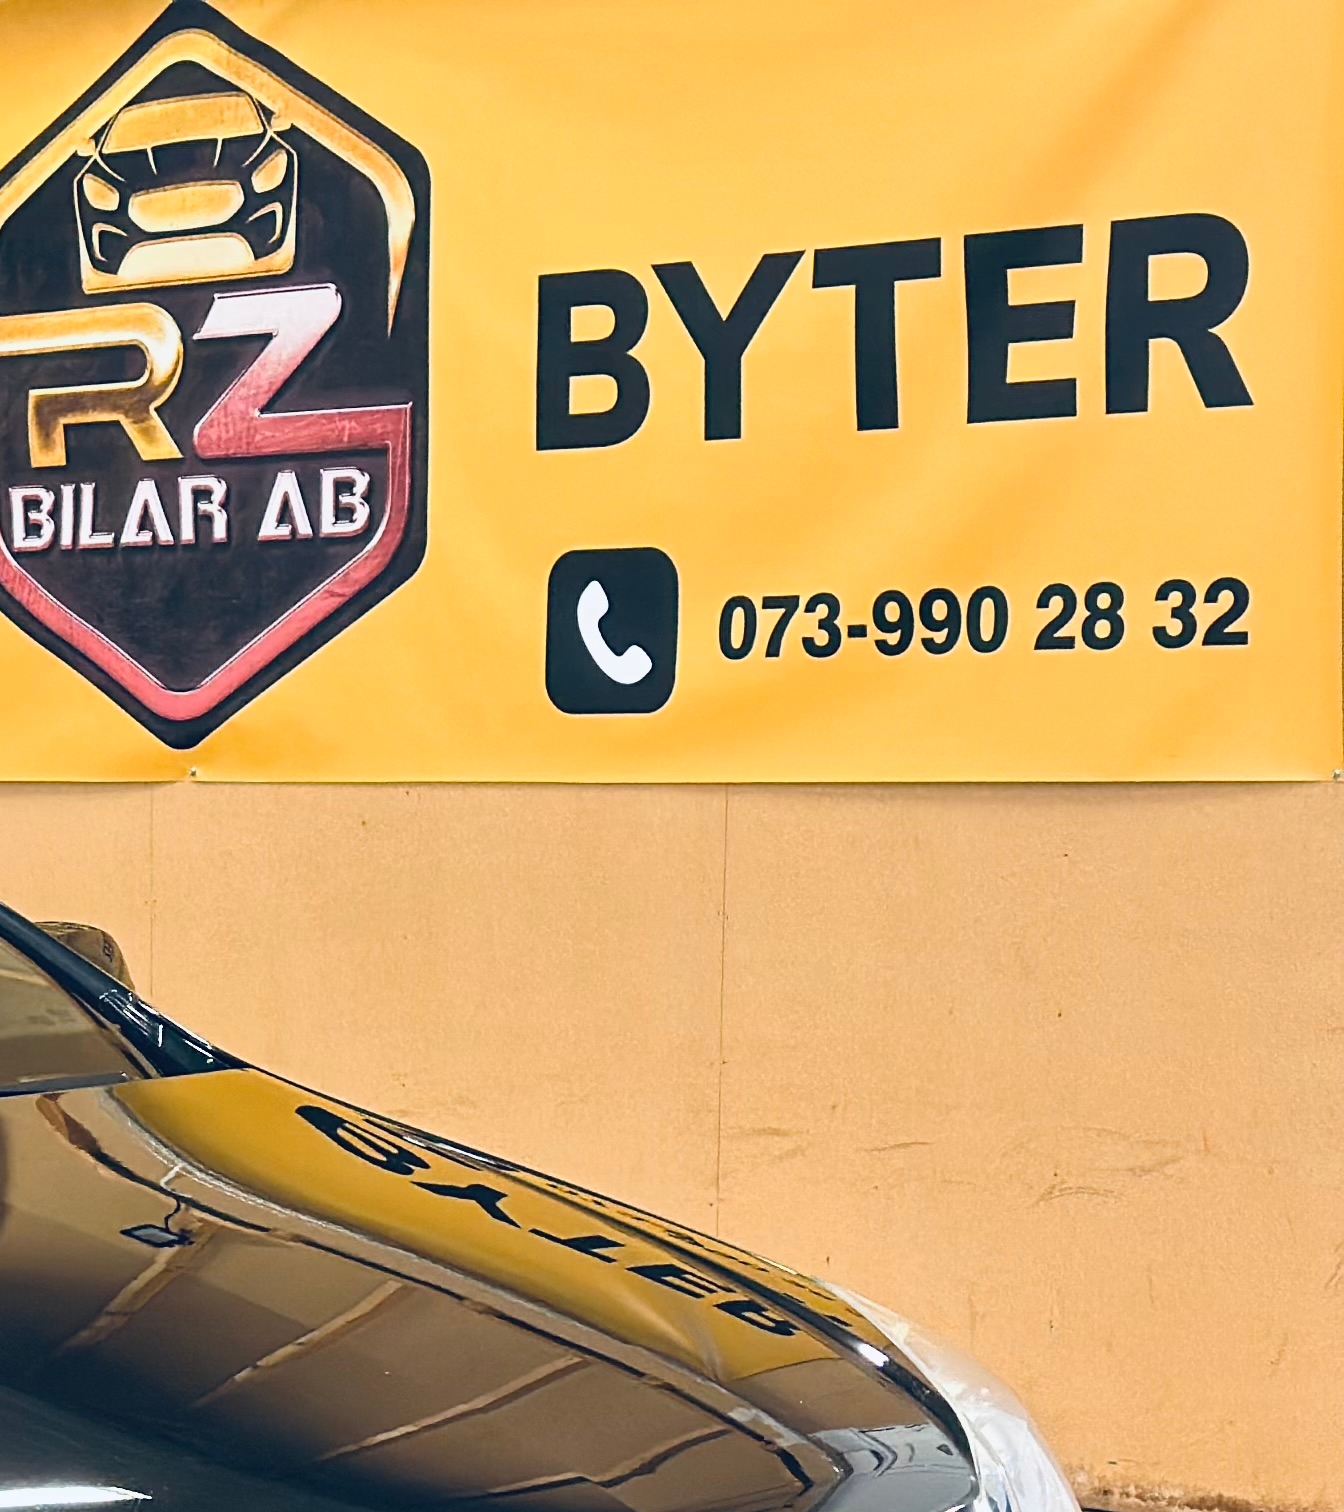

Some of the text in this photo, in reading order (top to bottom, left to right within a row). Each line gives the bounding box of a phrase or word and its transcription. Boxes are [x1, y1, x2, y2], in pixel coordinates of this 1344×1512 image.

[535, 212, 1255, 452] BYTER
[8, 466, 371, 552] BILAR AB
[718, 576, 1250, 661] 073-990 28 32
